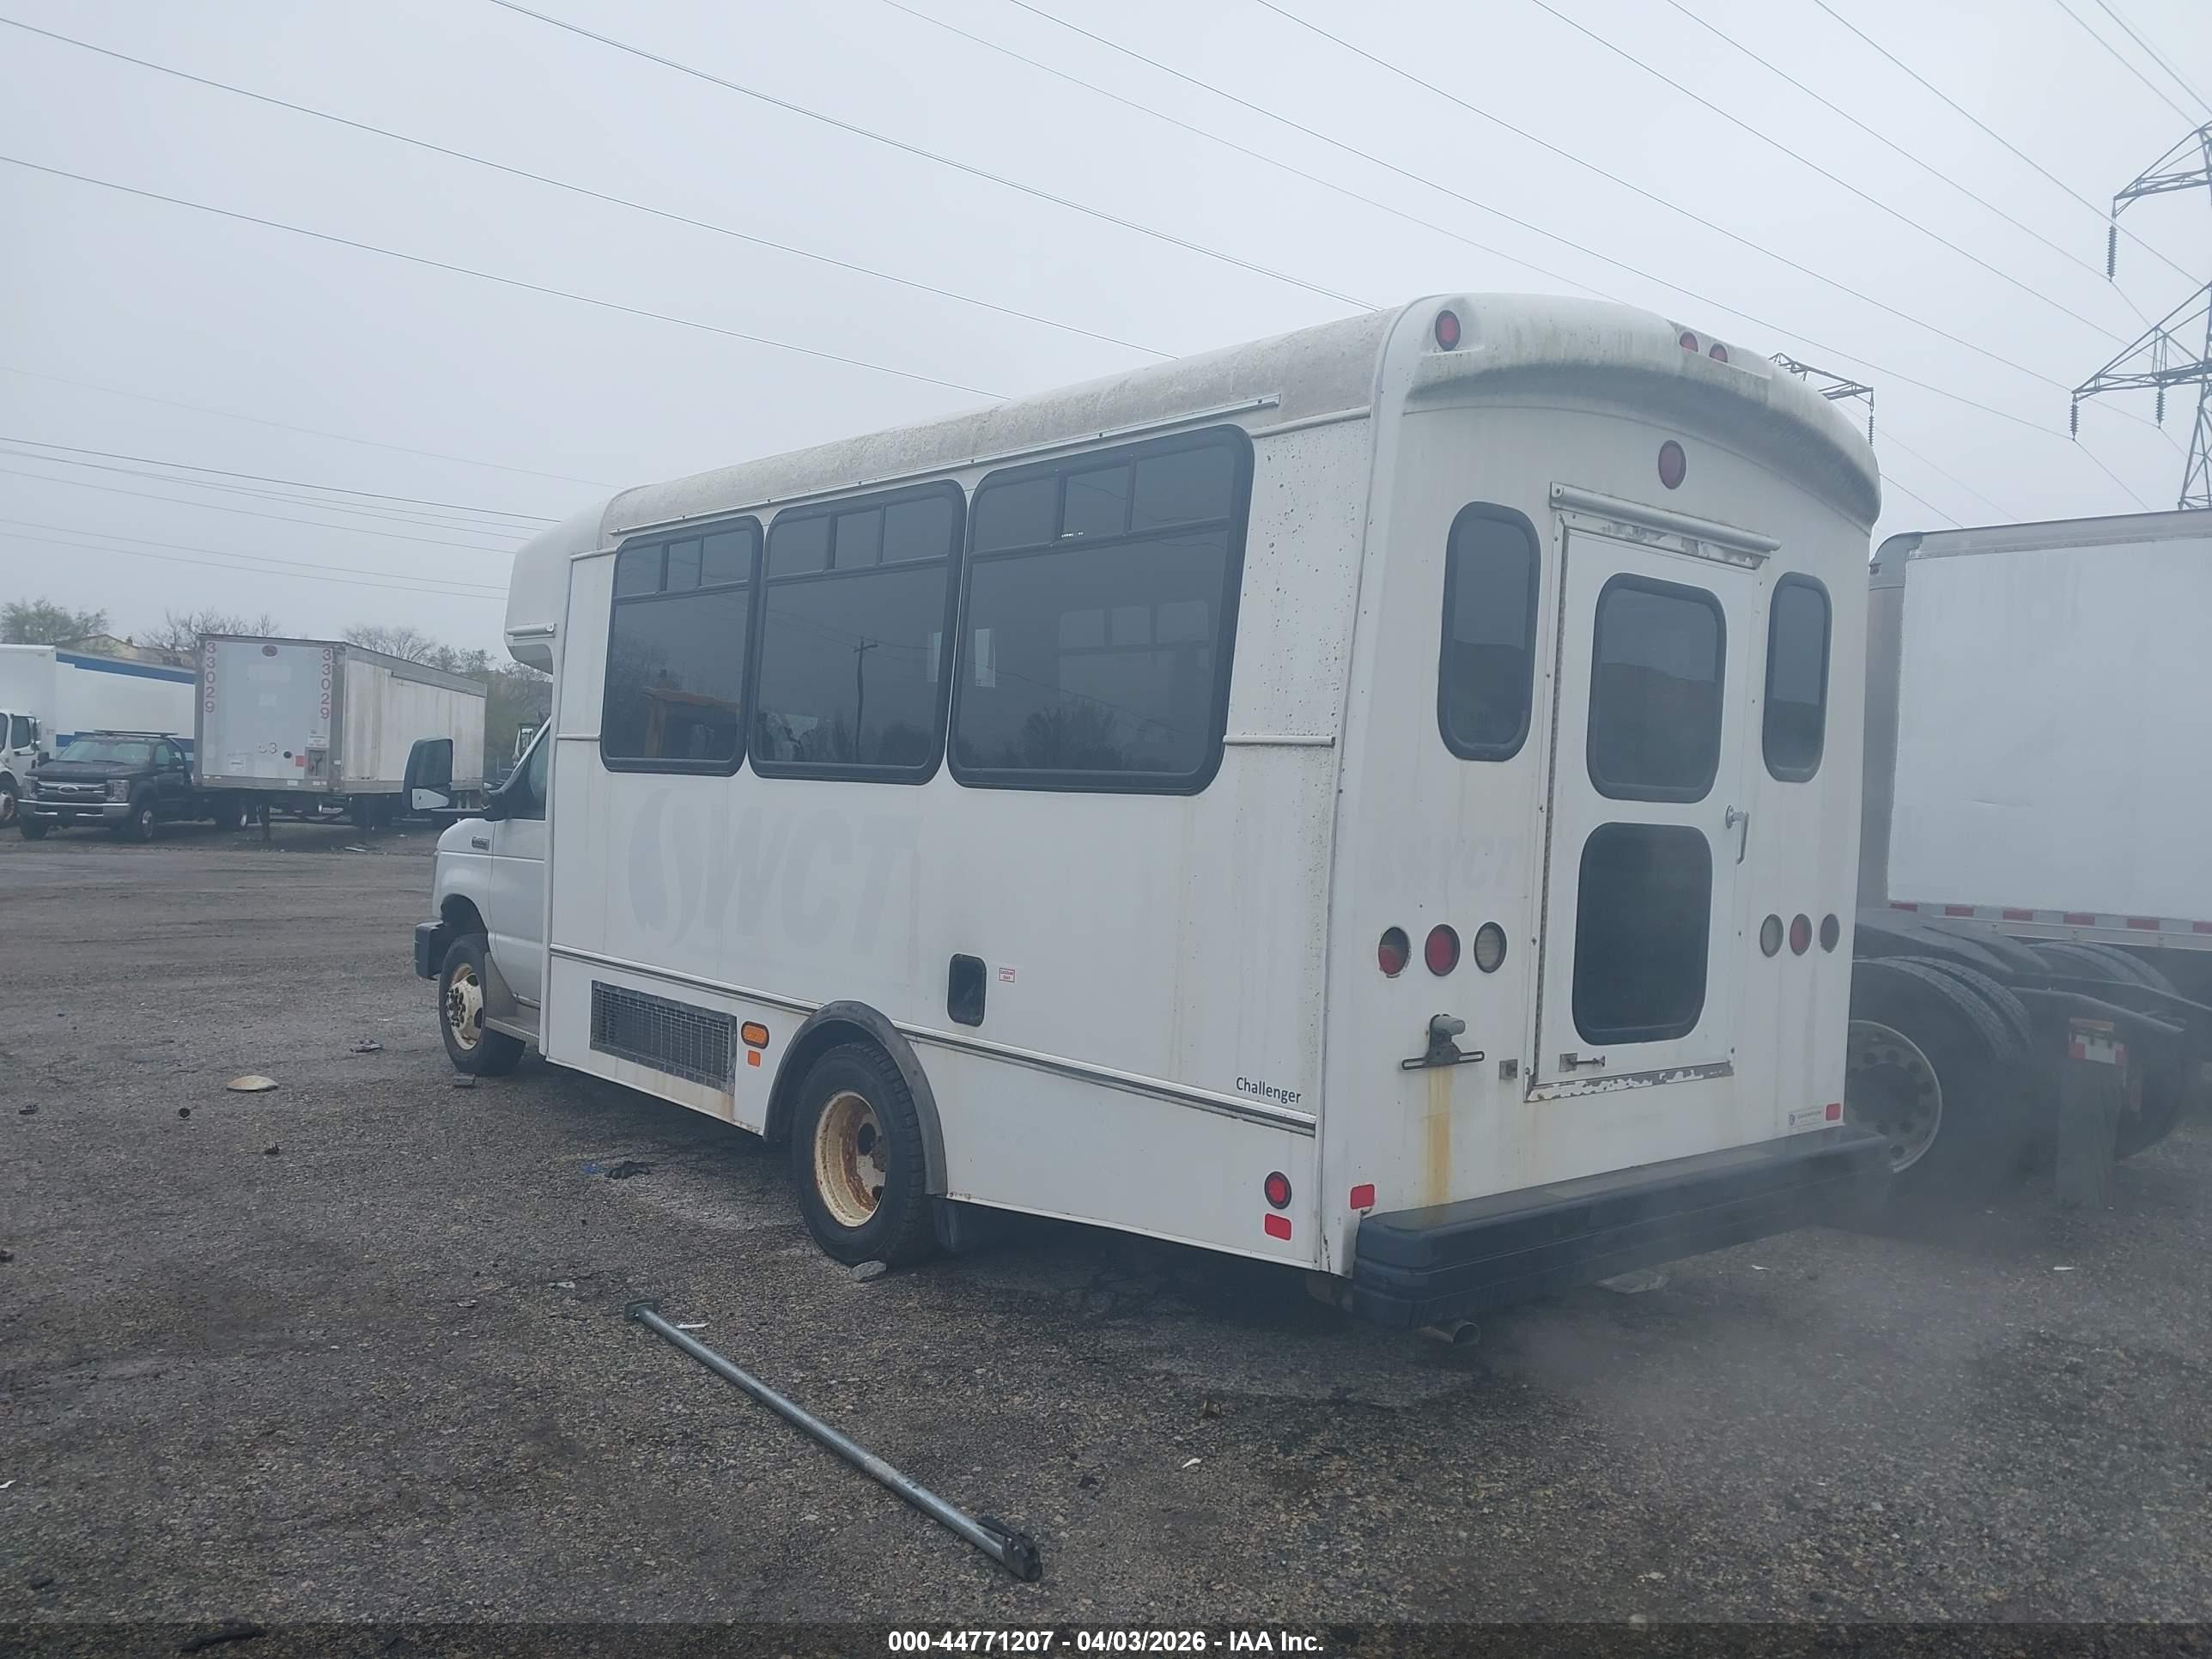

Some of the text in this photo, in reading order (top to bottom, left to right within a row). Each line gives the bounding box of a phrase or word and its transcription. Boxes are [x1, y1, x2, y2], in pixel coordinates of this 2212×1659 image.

[205, 641, 217, 714] 33029
[319, 648, 332, 720] 33029
[1236, 1076, 1302, 1104] Challenger
